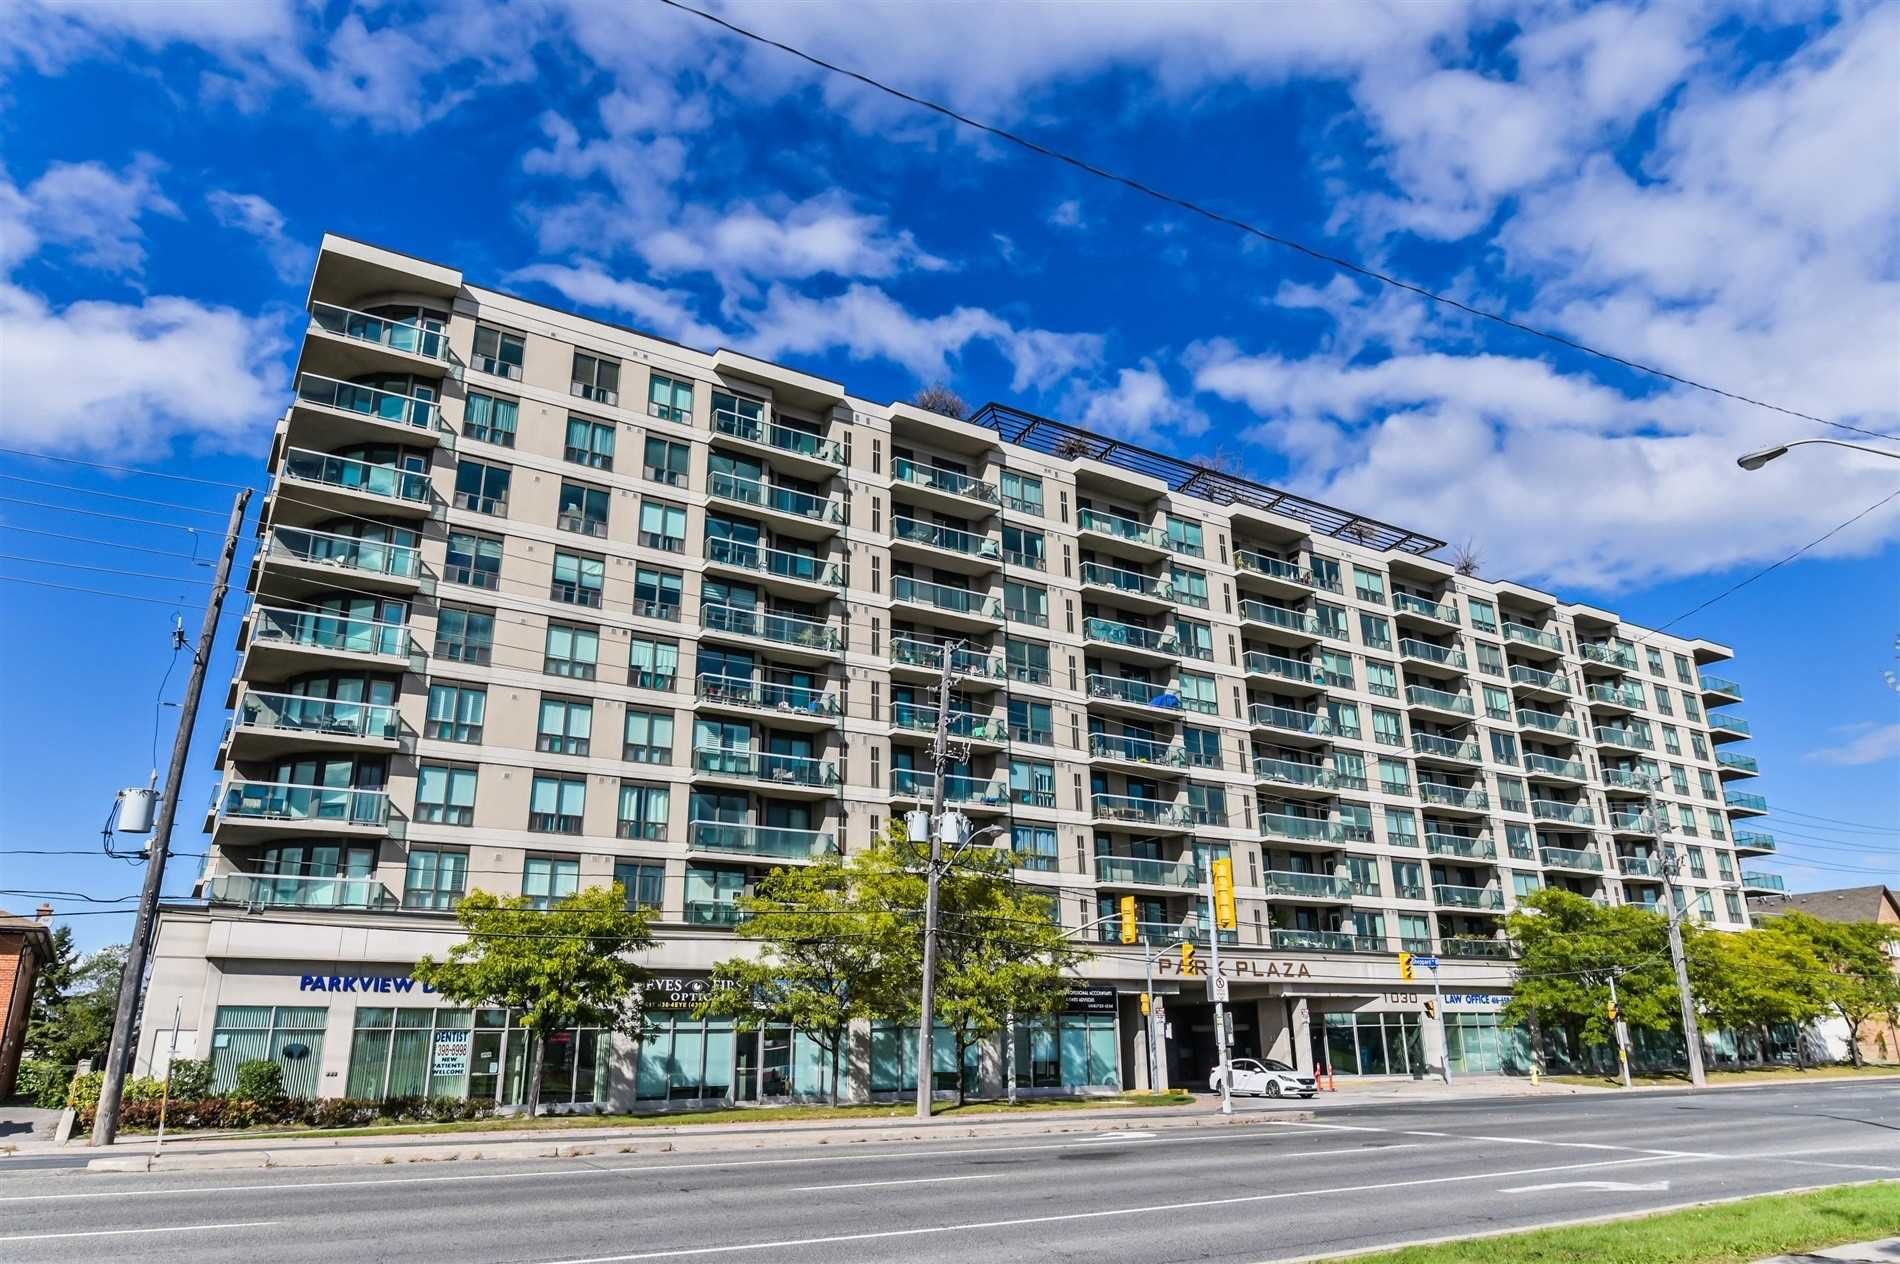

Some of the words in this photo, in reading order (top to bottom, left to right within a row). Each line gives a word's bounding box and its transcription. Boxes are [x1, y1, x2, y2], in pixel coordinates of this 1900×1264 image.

[1235, 961, 1312, 978] PLAZA
[300, 975, 416, 993] PARKVIEW
[646, 979, 682, 991] EYES
[713, 979, 744, 992] FIRS
[1382, 992, 1418, 1003] 1030
[1444, 994, 1462, 1004] LAW
[1465, 994, 1490, 1005] OFFICE
[435, 1031, 469, 1043] DENTIST
